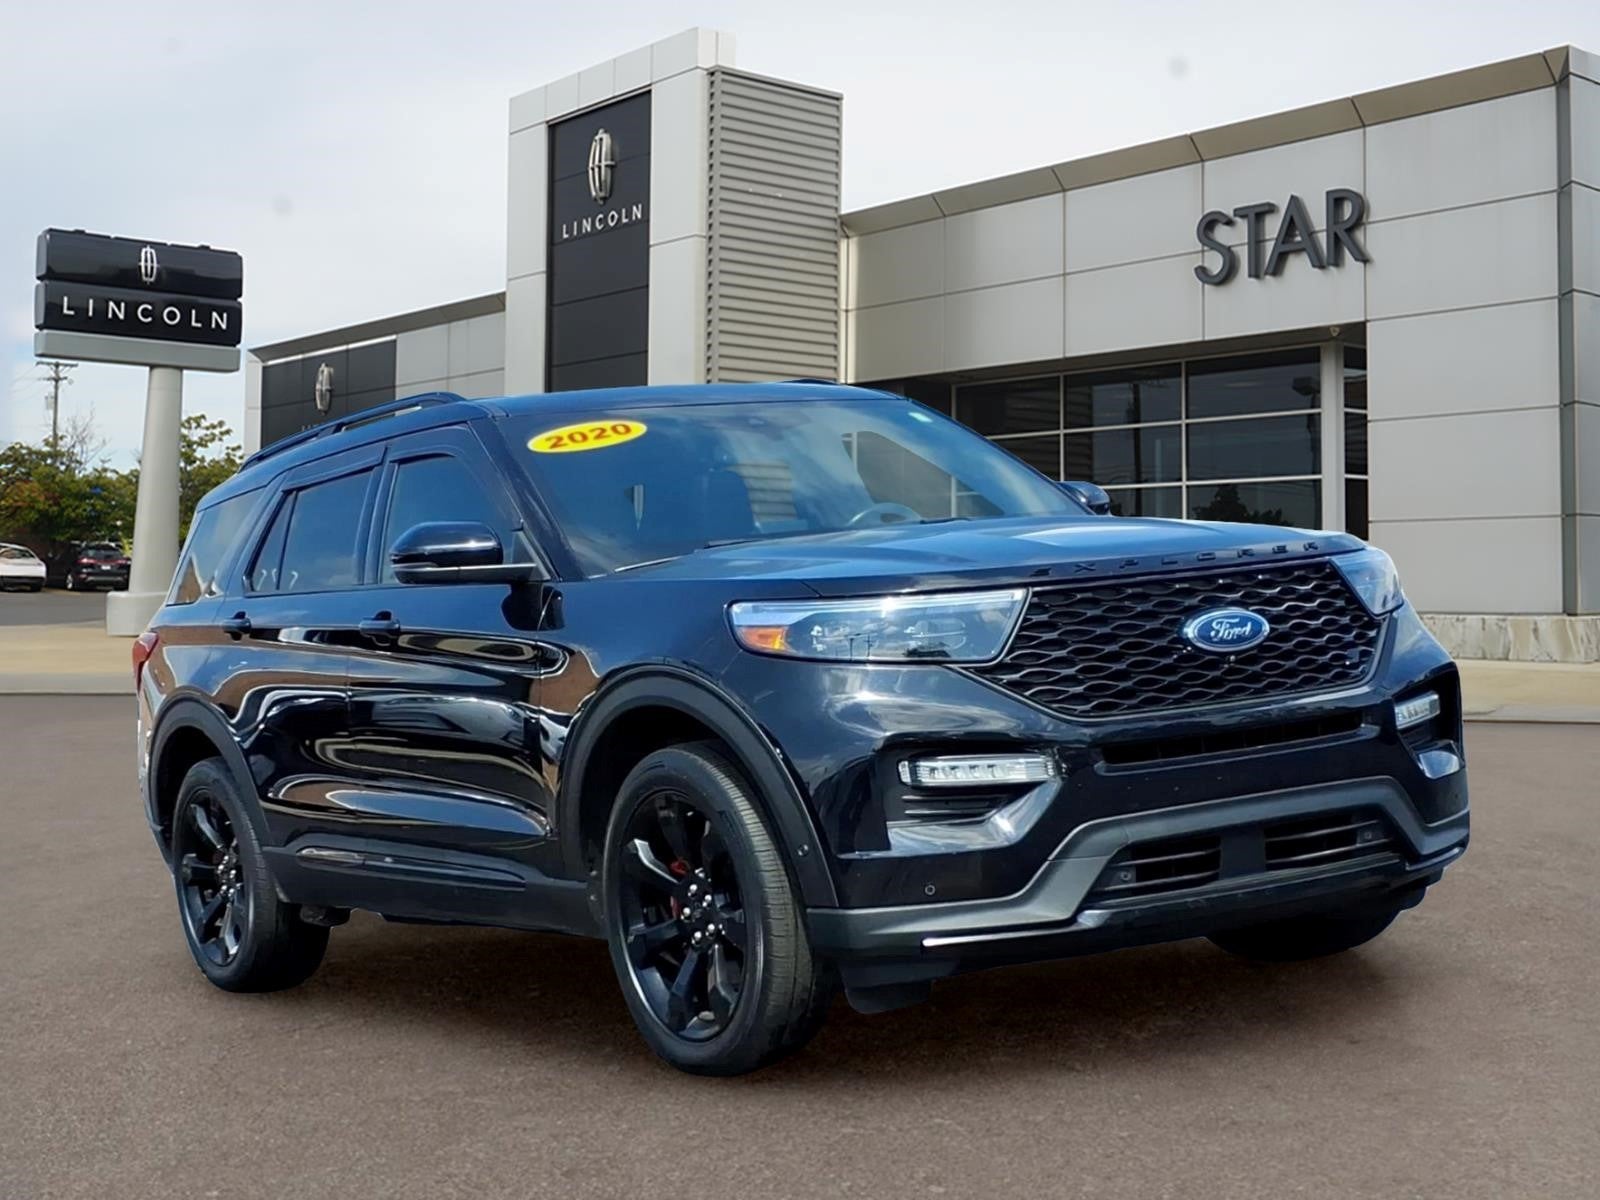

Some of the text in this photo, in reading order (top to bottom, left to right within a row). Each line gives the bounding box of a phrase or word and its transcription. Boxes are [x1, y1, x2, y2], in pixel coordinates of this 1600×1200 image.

[562, 203, 643, 239] LINCOLN
[1194, 188, 1371, 286] STAR
[62, 296, 228, 330] LINCOLN
[545, 423, 632, 450] 2020
[1210, 617, 1252, 641] Ford
